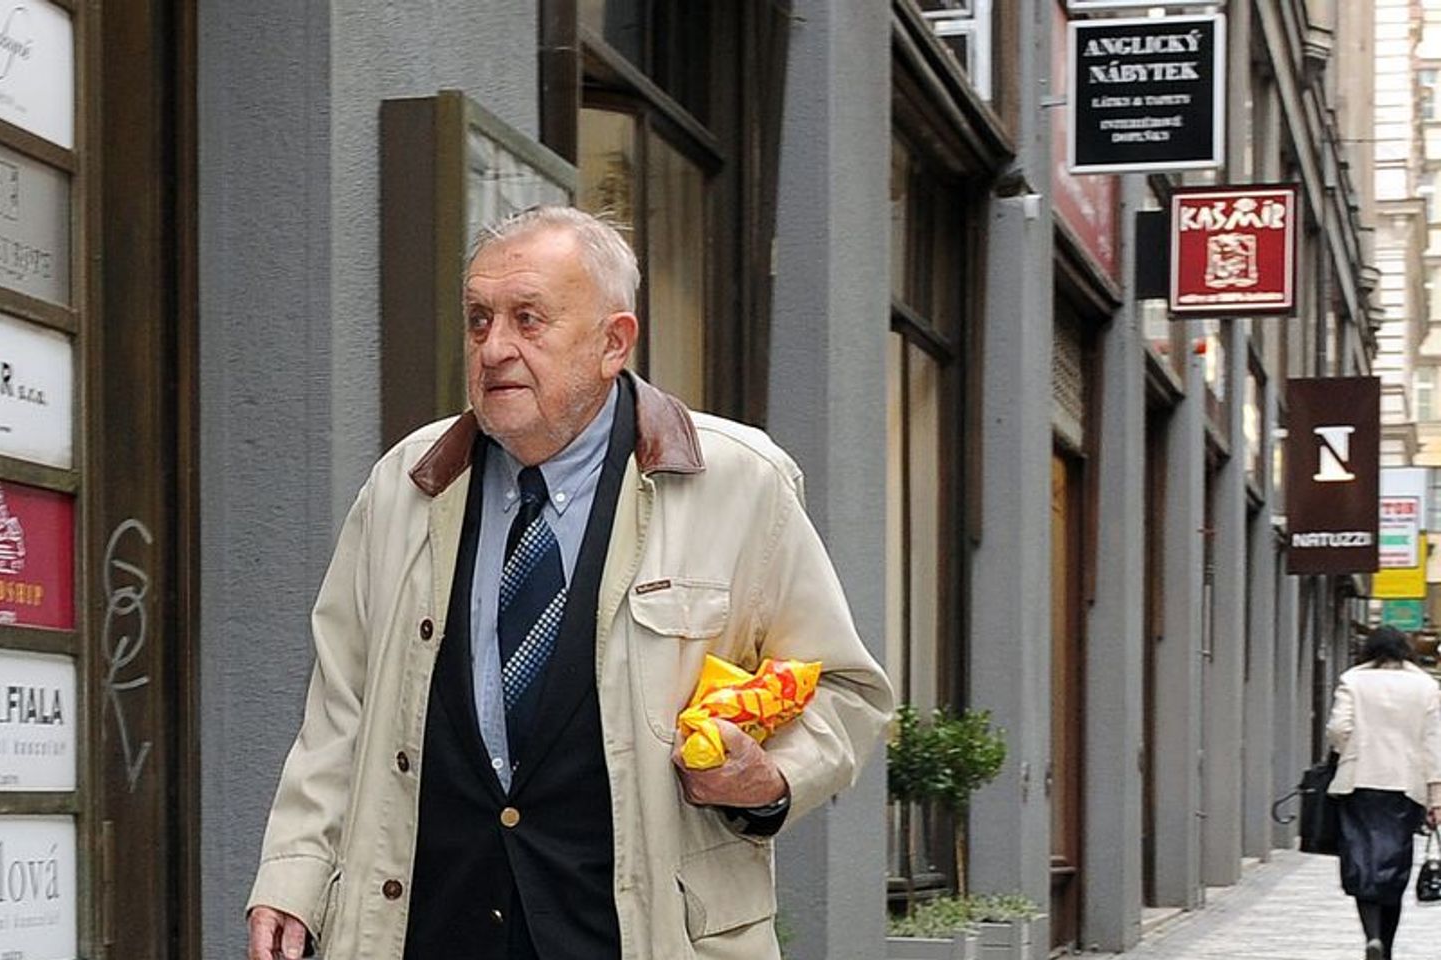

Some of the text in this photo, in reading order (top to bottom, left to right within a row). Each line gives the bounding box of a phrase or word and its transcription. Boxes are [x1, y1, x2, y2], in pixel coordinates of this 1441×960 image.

[1083, 29, 1203, 56] ANGLICKÝ
[1089, 60, 1200, 84] NÁBYTEK
[1180, 197, 1286, 232] KAŠMÍR
[1313, 426, 1356, 482] N
